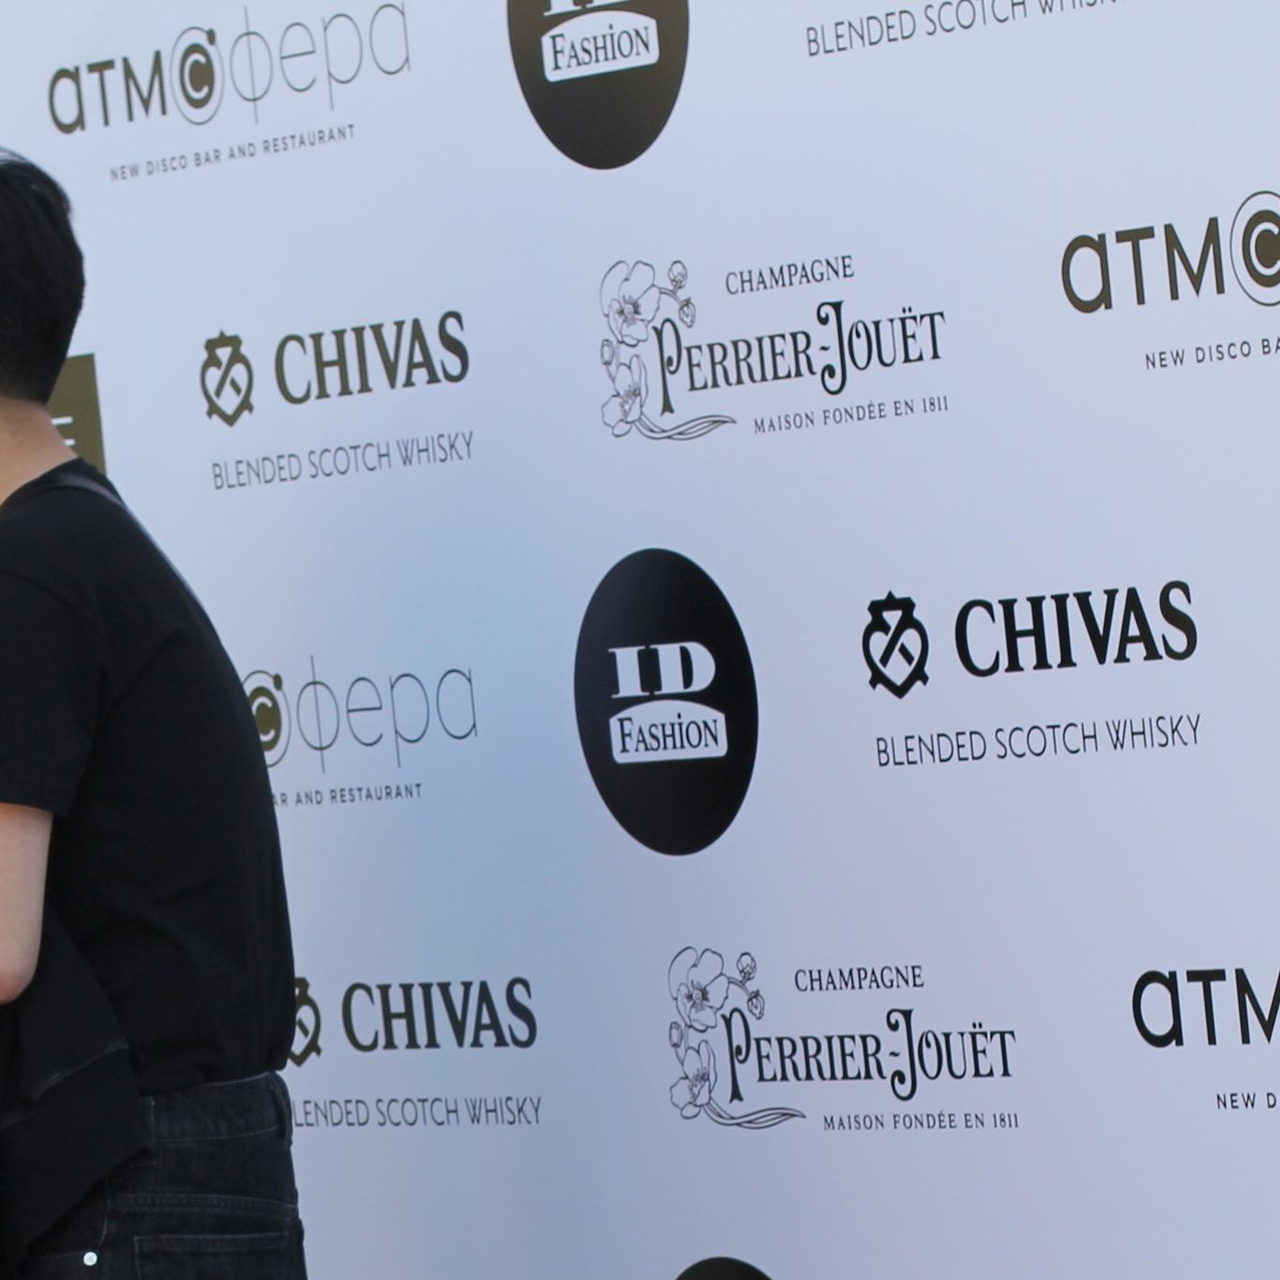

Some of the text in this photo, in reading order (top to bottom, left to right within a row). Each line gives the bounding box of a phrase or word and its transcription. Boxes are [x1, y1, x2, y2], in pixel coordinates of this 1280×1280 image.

[806, 8, 917, 57] BLENDED
[110, 124, 356, 182] NEW DISCO BAR AND RESTAURANT
[726, 255, 855, 295] CHAMPAGNE
[274, 310, 469, 404] CHIVAS
[1145, 349, 1186, 370] NEW
[1195, 340, 1252, 364] DISCO
[754, 396, 949, 434] MAISON FONDÉE EN 1811
[212, 431, 473, 490] BLENDED SCOTCH WHISKY
[955, 580, 1197, 677] CHIVAS
[608, 641, 716, 699] ID
[877, 713, 1200, 767] BLENDED SCOTCH WHISKY
[295, 790, 323, 806] AND
[330, 783, 422, 804] RESTAURANT
[794, 965, 925, 992] CHAMPAGNE
[342, 977, 537, 1052] CHIVAS
[292, 1097, 541, 1127] LENDED SCOTCH WHISKY
[823, 1109, 1019, 1131] MAISON FONDÉE EN 1811
[1216, 1093, 1256, 1109] NEW
